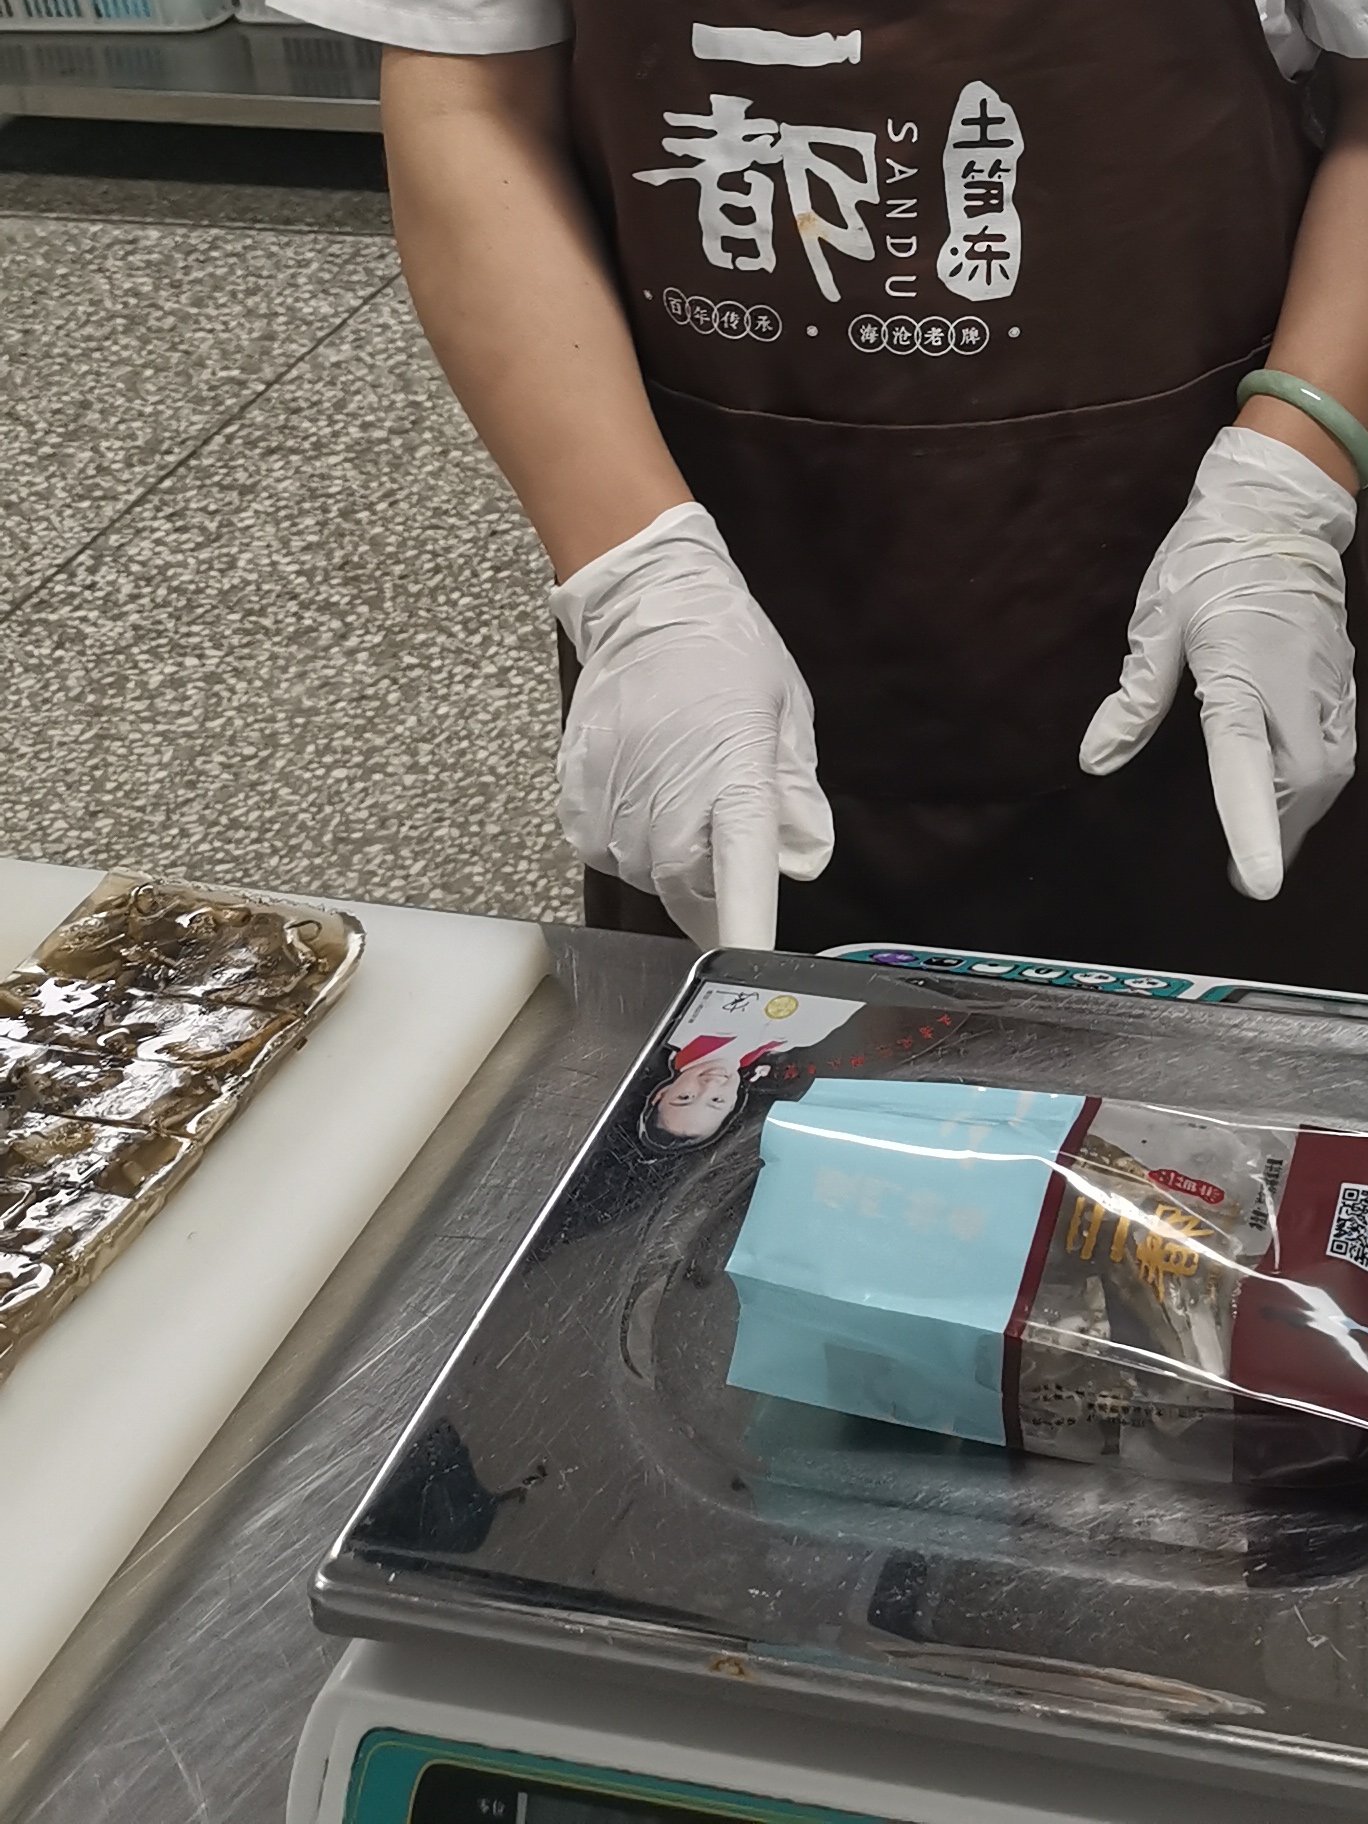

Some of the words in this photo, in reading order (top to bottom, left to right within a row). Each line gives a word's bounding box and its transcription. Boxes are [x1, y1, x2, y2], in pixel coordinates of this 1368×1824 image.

[884, 117, 920, 299] SANDU
[947, 96, 1016, 288] 土笋冻
[665, 292, 776, 337] 百年传承
[856, 320, 984, 349] 海沧老牌
